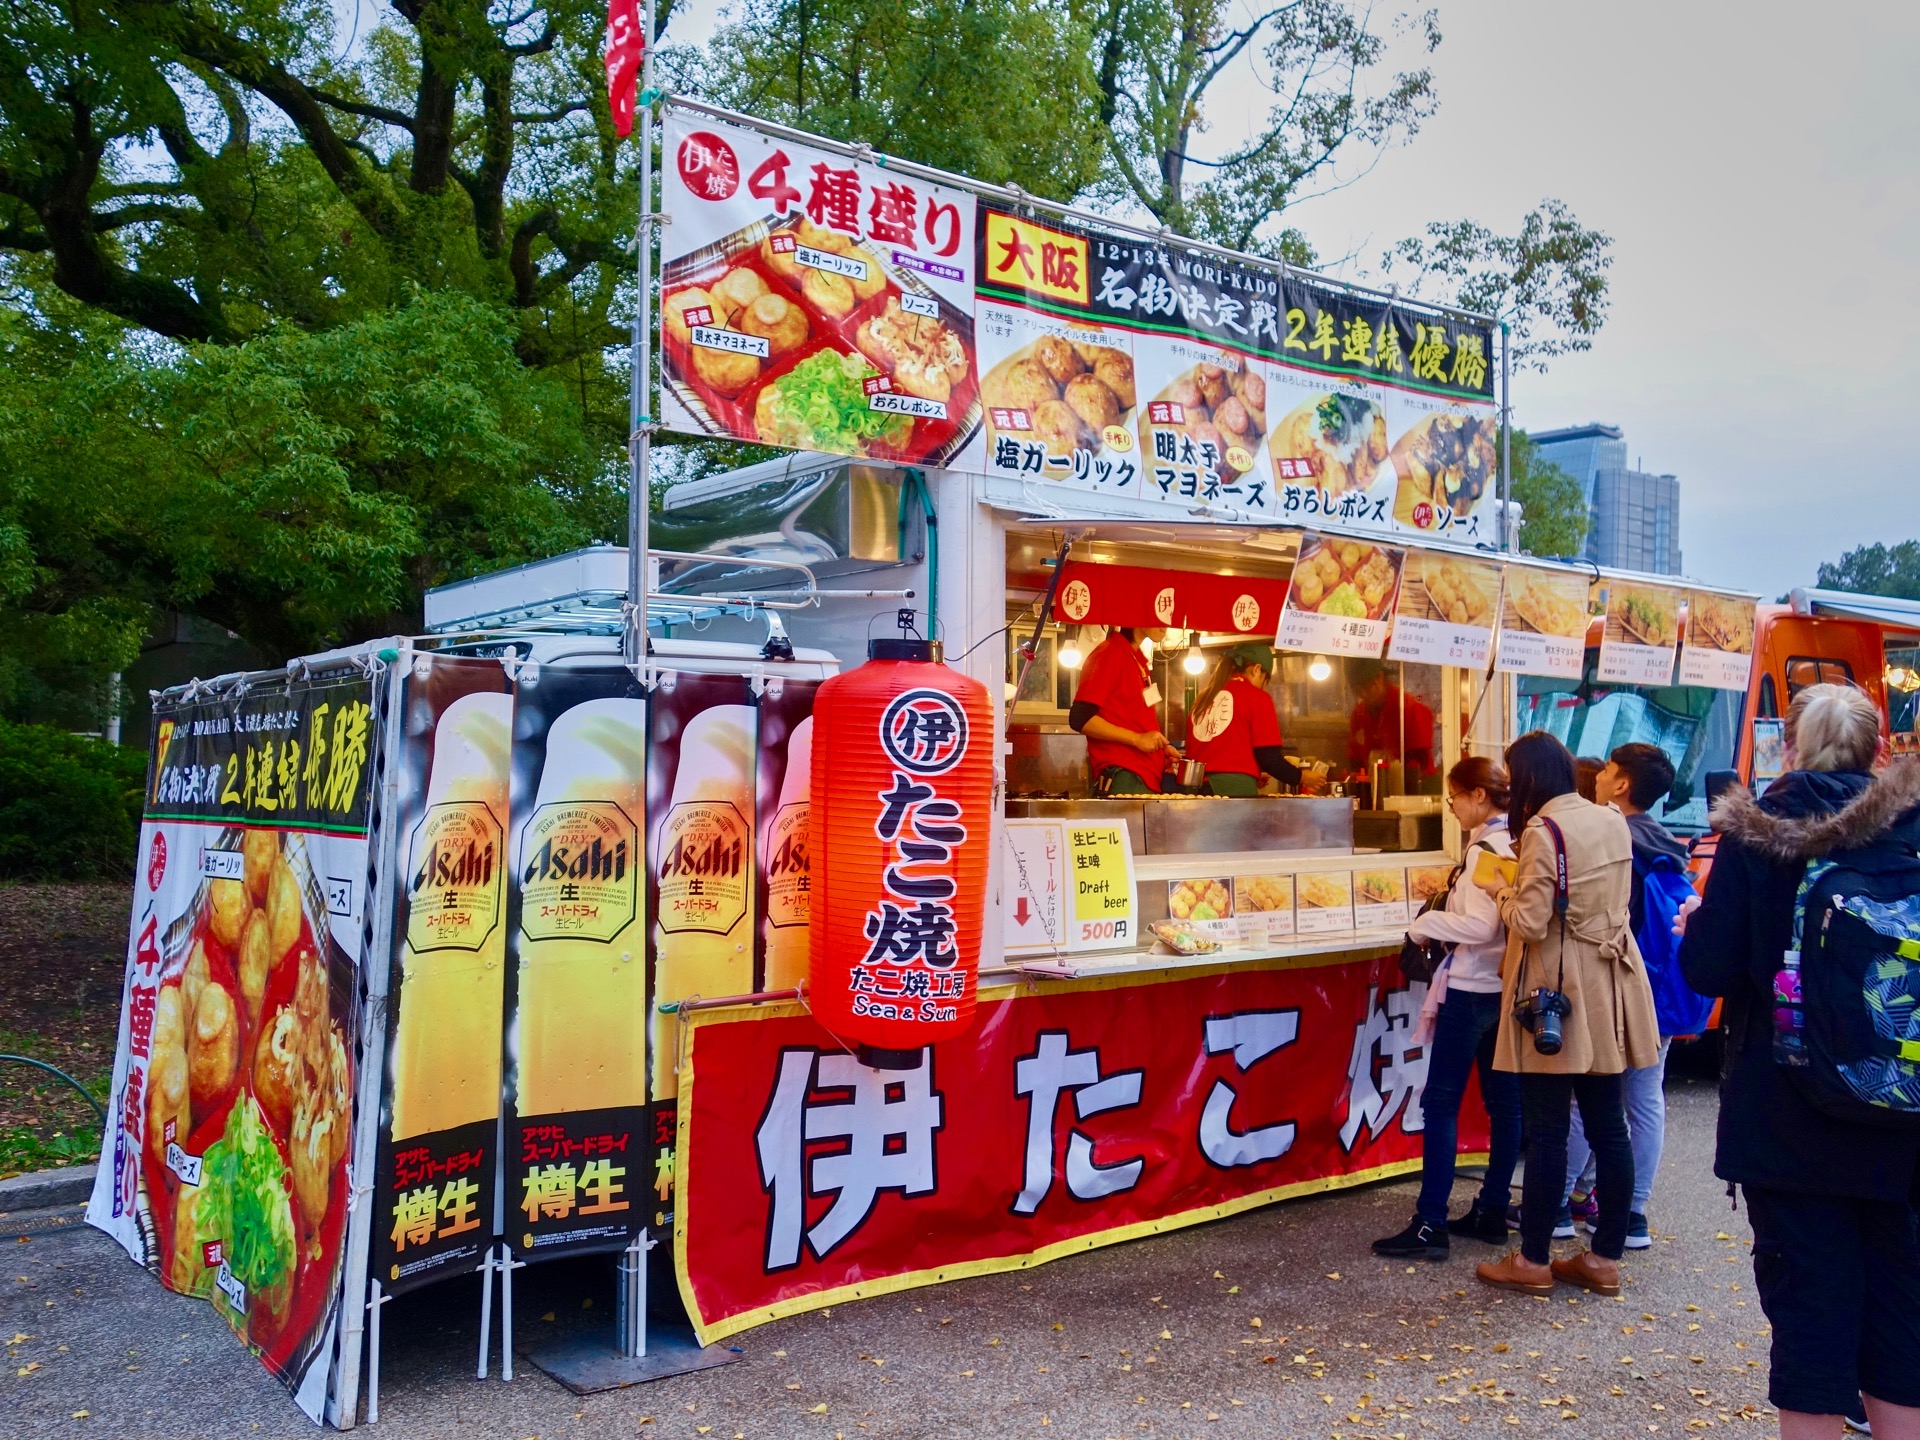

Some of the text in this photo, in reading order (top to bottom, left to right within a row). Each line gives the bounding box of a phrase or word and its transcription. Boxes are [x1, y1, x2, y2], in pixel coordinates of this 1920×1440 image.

[747, 149, 962, 257] 4種盛り
[772, 236, 795, 252] 元祖
[799, 249, 863, 277] 塩ガーリック
[995, 226, 1081, 293] 大阪
[1178, 259, 1277, 296] MORI-KADO
[902, 295, 936, 315] ソース
[1095, 266, 1279, 344] 名物決定戦
[686, 309, 712, 326] 元祖
[694, 327, 766, 353] 明太子マヨネーズ
[985, 323, 1013, 338] います
[1283, 307, 1488, 390] 2年連続優勝
[865, 377, 891, 393] 元祖
[872, 394, 944, 416] おろしポンズ
[1151, 403, 1184, 423] 元祖
[994, 409, 1030, 429] 元祖
[1105, 431, 1131, 446] 手作り
[1155, 430, 1220, 469] 明太子
[995, 435, 1137, 488] 塩ガーリック
[1228, 452, 1252, 468] 手作り
[1280, 461, 1313, 476] 元祖
[1155, 467, 1268, 508] マヨネーズ
[1283, 485, 1390, 523] おろしポンズ
[1436, 507, 1479, 538] ソース
[1341, 622, 1375, 638] 4種盛り
[540, 810, 610, 835] ASAHI BREWERIES LIMITED
[1073, 831, 1119, 847] 生ビール
[205, 855, 241, 874] 塩ガーリッ
[413, 839, 493, 893] Asahi
[524, 836, 626, 885] Asahi
[660, 835, 741, 880] Asahi
[1076, 853, 1101, 869] 生啤
[560, 883, 580, 901] 生
[688, 878, 704, 896] 生
[797, 875, 811, 892] 生
[1079, 879, 1110, 895] Draft
[442, 889, 458, 910] 生
[673, 898, 719, 911] スーパードライ
[782, 894, 810, 907] スーパー
[1104, 896, 1128, 909] beer
[426, 912, 472, 928] スーパードライ
[540, 904, 599, 917] スーパードライ
[684, 911, 708, 923] 生ビール
[793, 905, 810, 917] 生ビー
[437, 926, 460, 940] 生ビール
[555, 918, 585, 929] 生ビール
[1081, 920, 1127, 941] 500円
[850, 966, 965, 1000] たこ焼工房
[852, 995, 957, 1022] Sea & Sun
[521, 1124, 565, 1144] アサヒ
[521, 1132, 630, 1163] スーパードライ
[395, 1147, 431, 1169] アサヒ
[393, 1148, 484, 1190] スーパードライ
[520, 1158, 630, 1224] 樽生
[390, 1177, 481, 1253] 樽生
